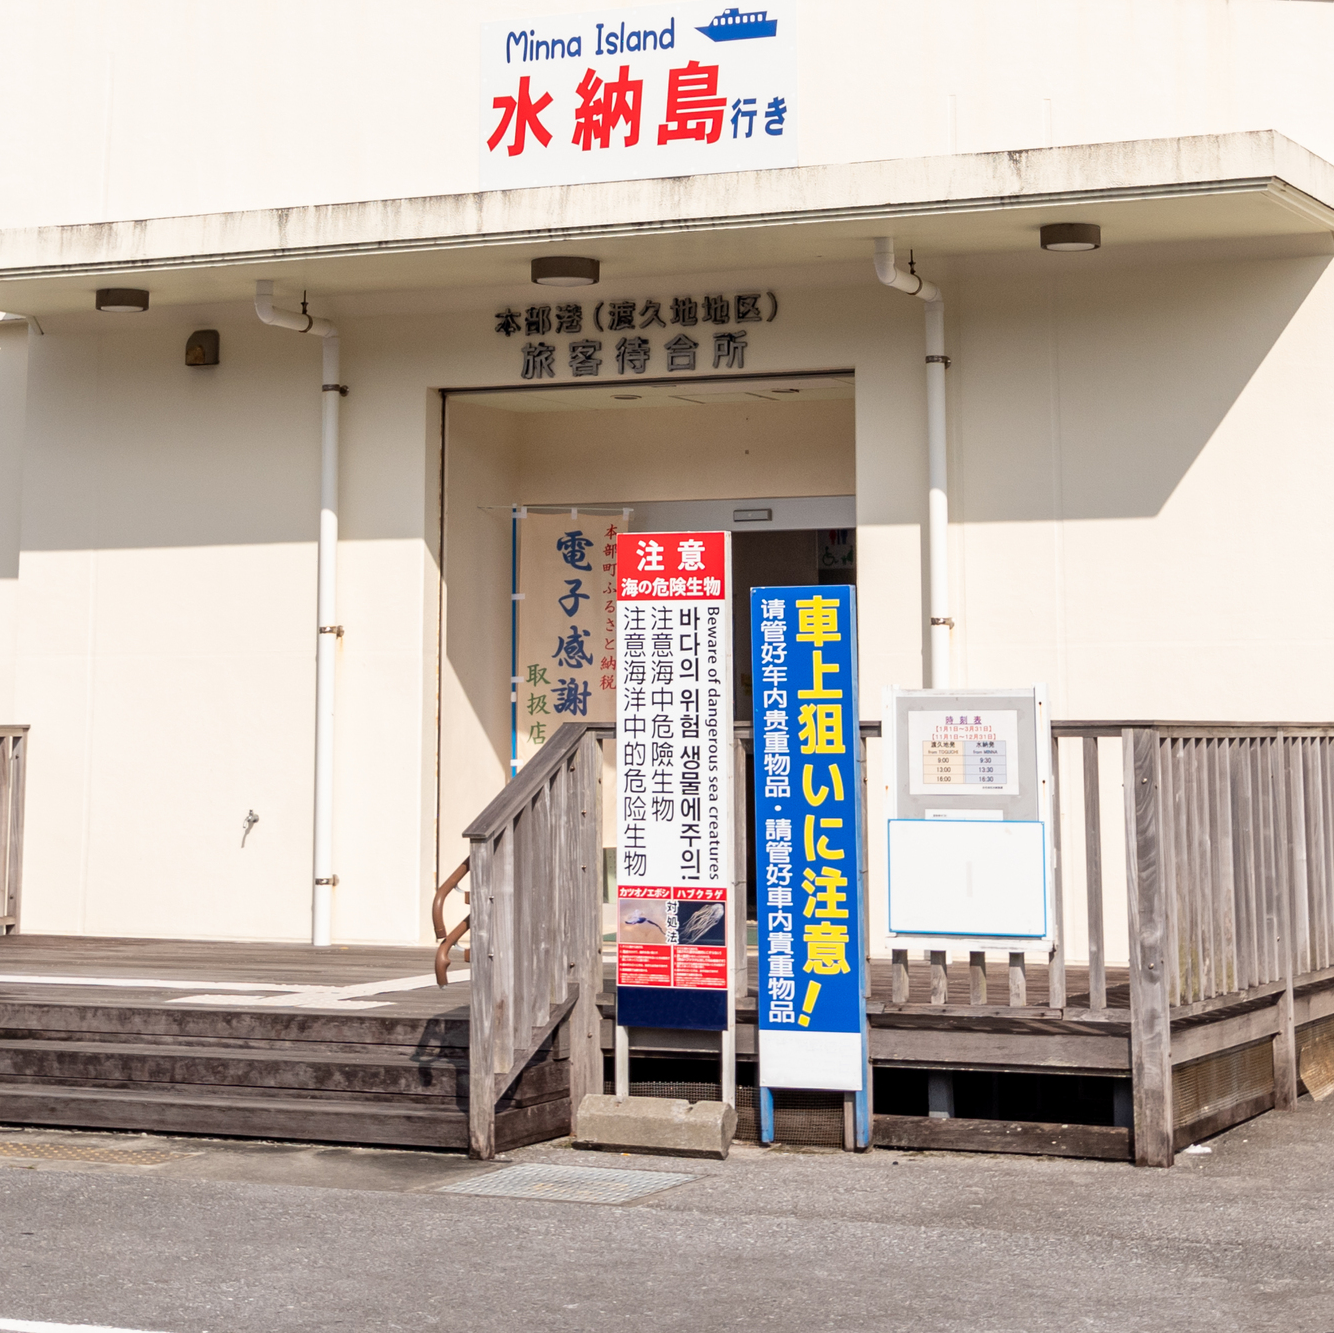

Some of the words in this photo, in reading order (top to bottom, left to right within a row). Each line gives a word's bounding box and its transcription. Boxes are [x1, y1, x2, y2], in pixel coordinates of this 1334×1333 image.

[505, 29, 582, 64] Minna
[594, 17, 676, 57] Island
[520, 330, 748, 380] 旅客待合所
[635, 538, 706, 572] 注意
[620, 576, 722, 598] 海の危険生物
[550, 530, 595, 717] 電子感謝
[679, 606, 701, 682] 바다의
[707, 606, 720, 665] Beware
[707, 668, 721, 685] of
[526, 663, 551, 745] 取扱店
[651, 605, 675, 822] 注意海中危險生物
[679, 688, 700, 739] 위험
[623, 605, 647, 877] 注意海洋中的危险生物
[704, 688, 721, 772] dangerous
[708, 776, 719, 802] sea
[708, 806, 721, 880] creatures
[619, 887, 670, 898] カツオノエボシ
[676, 889, 724, 900] ハブクラゲ
[666, 900, 679, 943] 対処法
